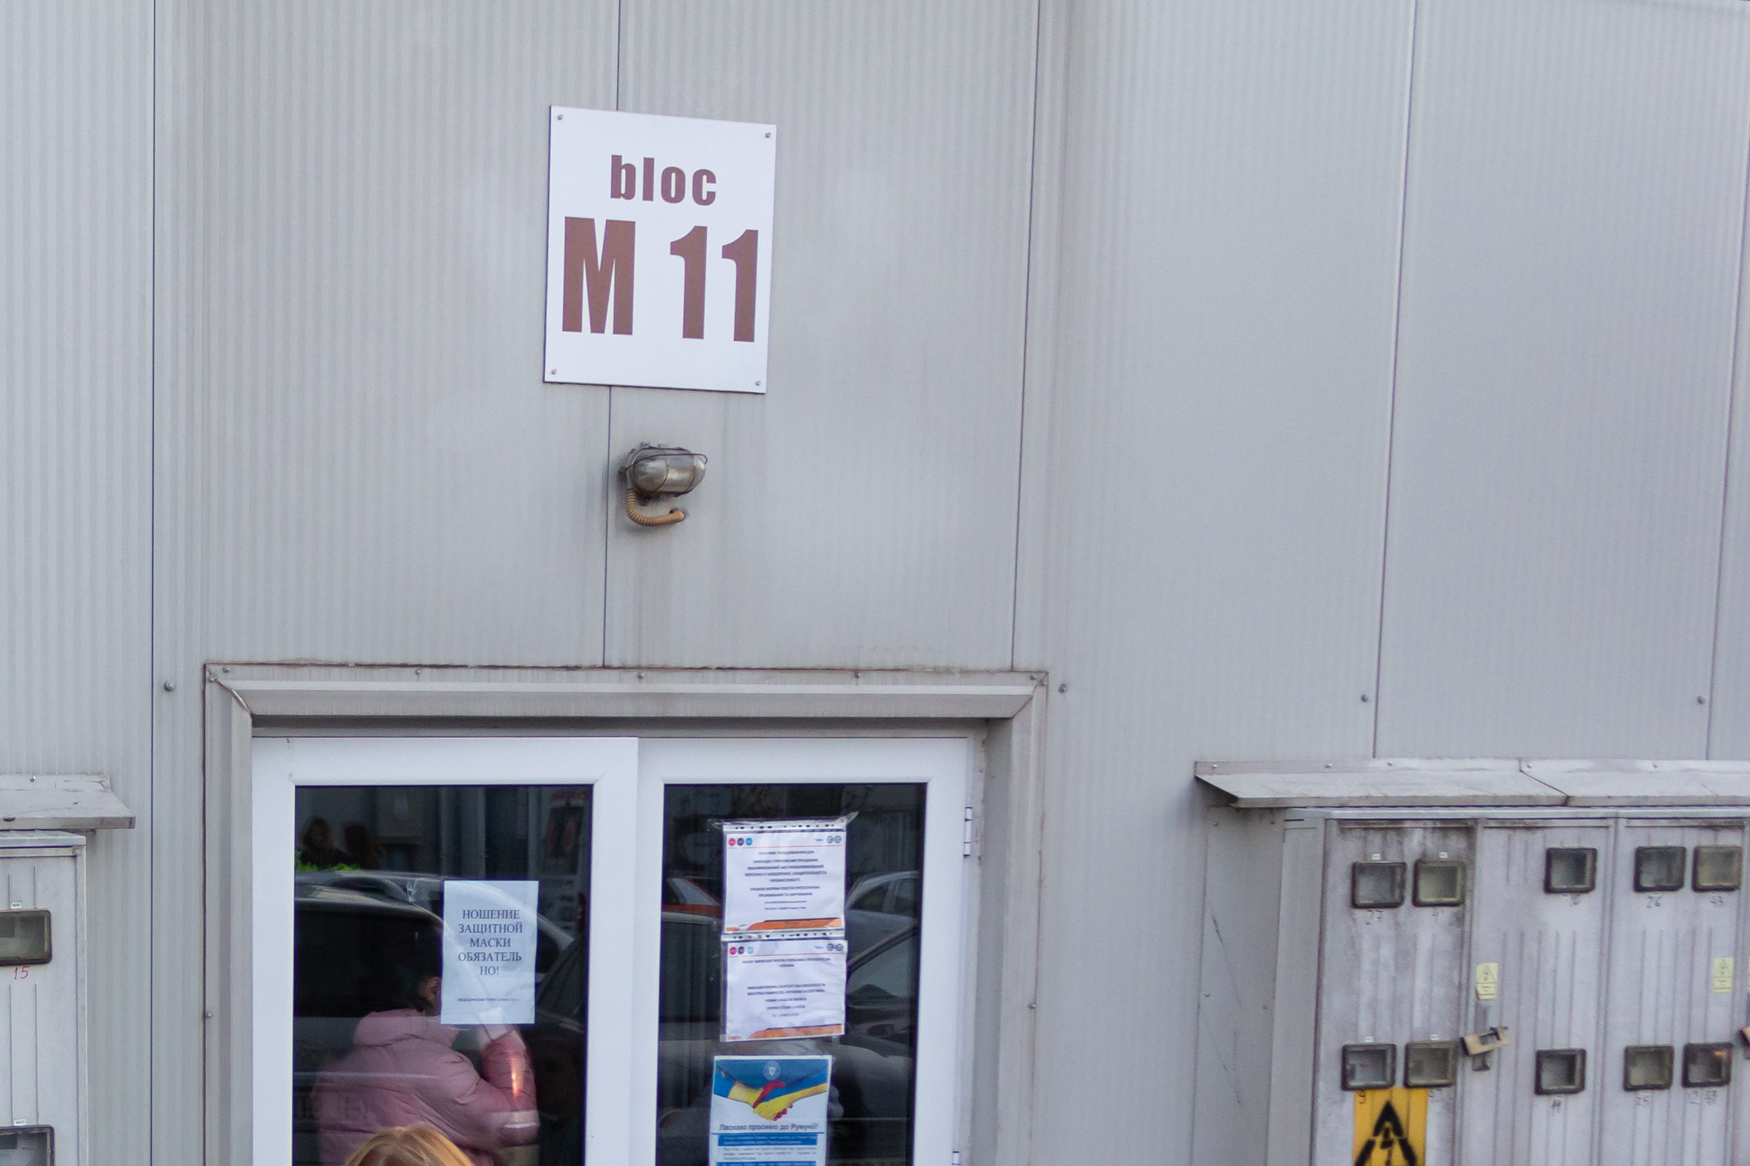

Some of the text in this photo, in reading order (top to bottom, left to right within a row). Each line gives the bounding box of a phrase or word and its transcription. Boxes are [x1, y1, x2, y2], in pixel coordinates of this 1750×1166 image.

[610, 154, 717, 206] bloc
[562, 216, 759, 342] M 11
[462, 909, 520, 919] НОШЕНИЕ
[458, 922, 523, 934] ЗАЩИТНОЙ
[470, 938, 511, 948] МАСКИ
[458, 952, 522, 962] ОБЯЗАТЕЛЬ
[13, 965, 31, 980] 15
[480, 966, 500, 975] НО!
